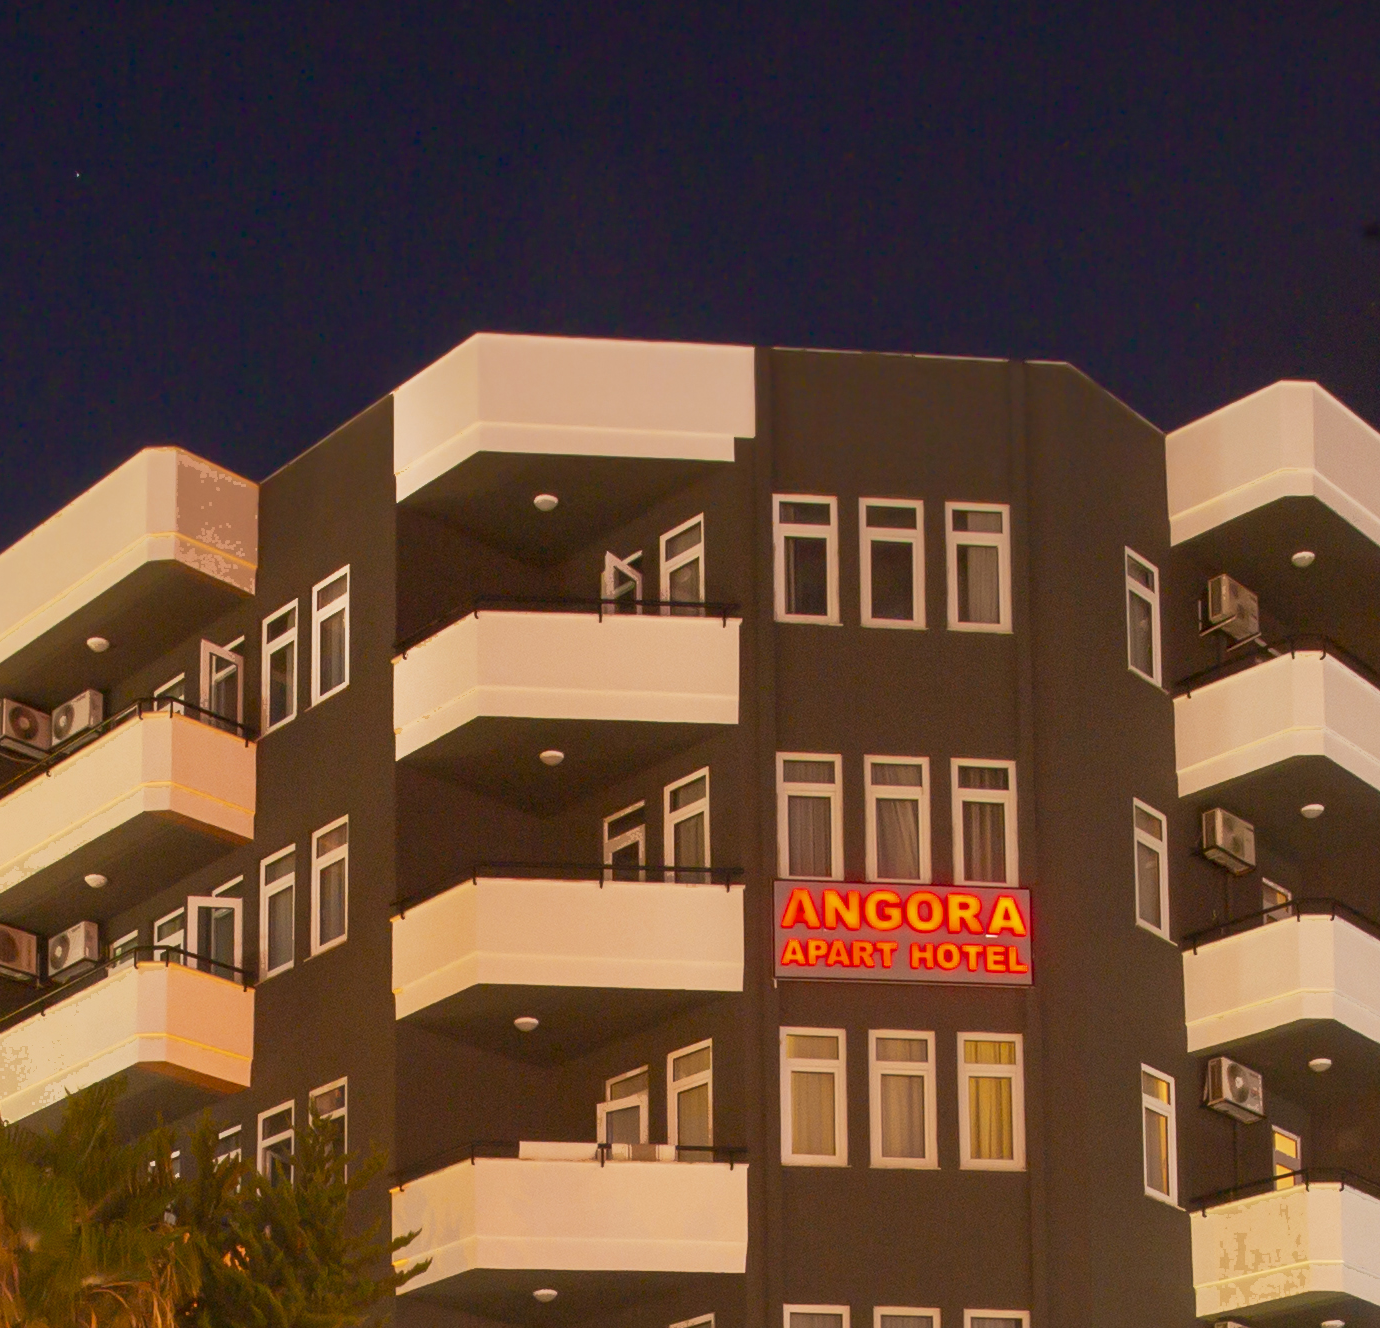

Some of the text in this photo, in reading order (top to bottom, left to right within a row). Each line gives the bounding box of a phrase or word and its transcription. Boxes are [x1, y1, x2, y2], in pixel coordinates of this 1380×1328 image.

[780, 888, 1027, 936] ANGORA
[780, 938, 1029, 973] APART HOTEL
